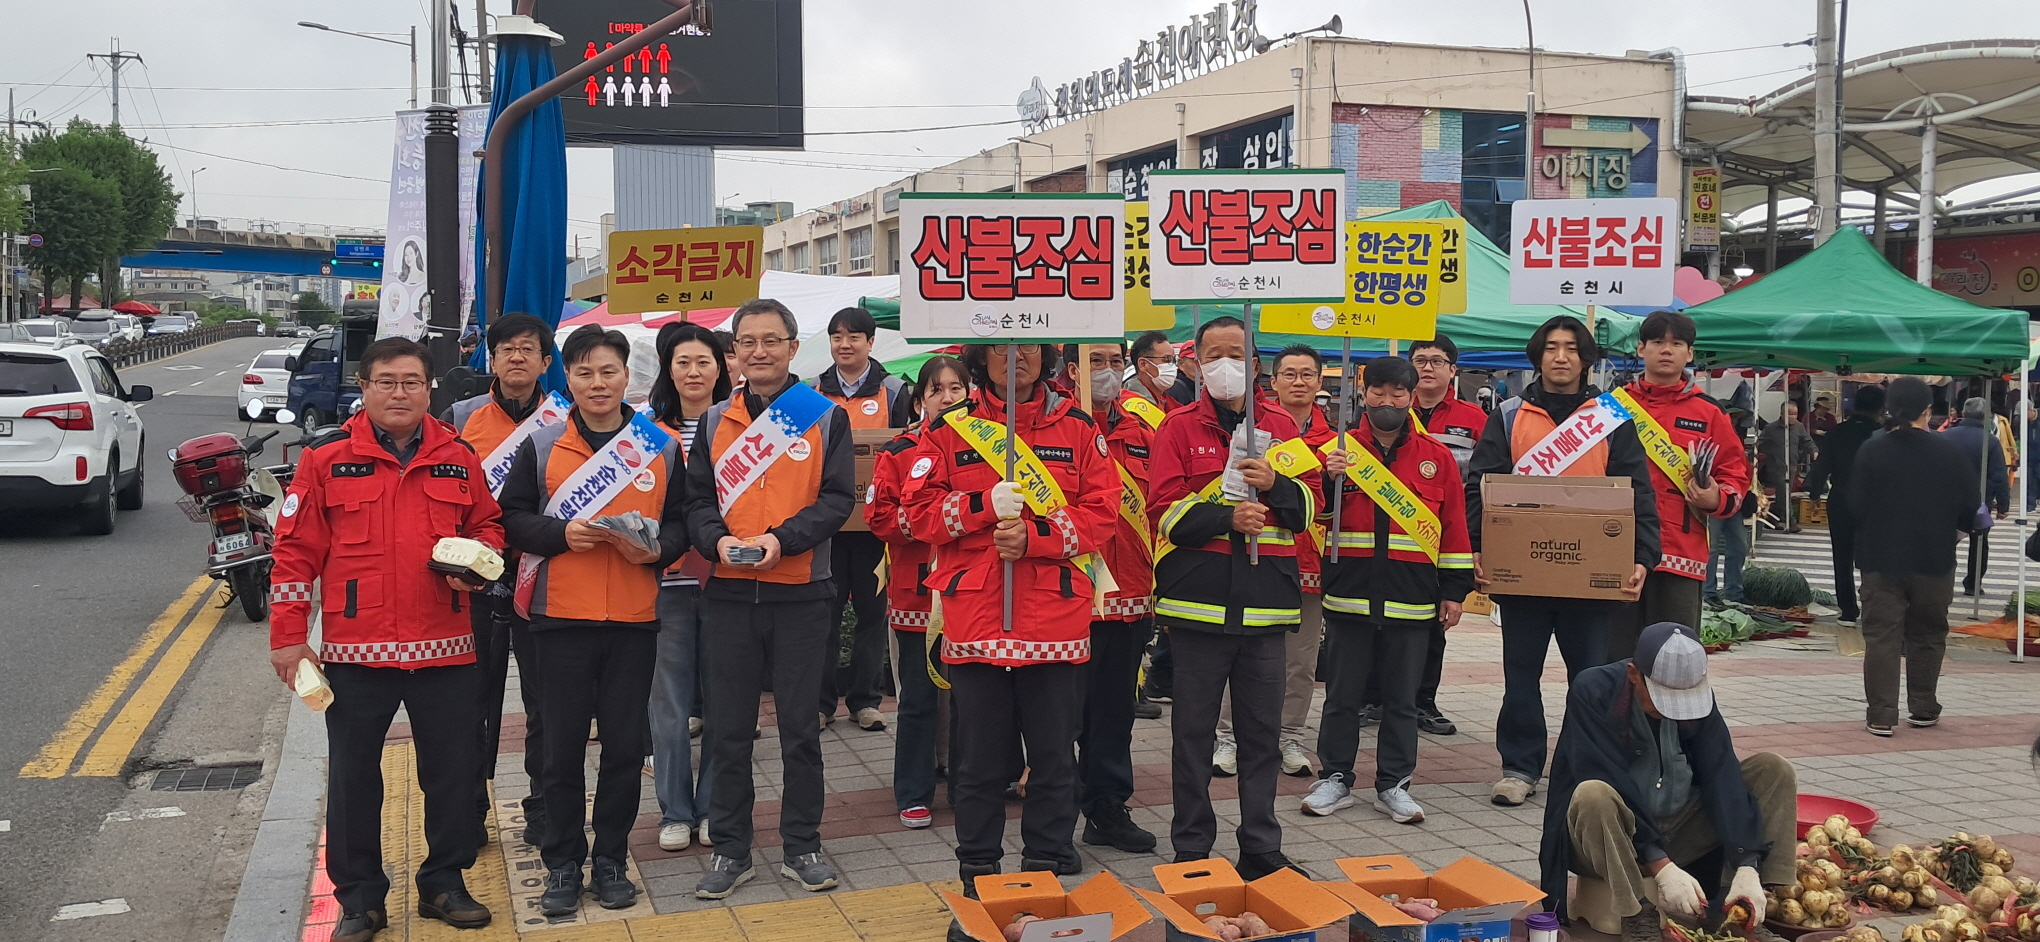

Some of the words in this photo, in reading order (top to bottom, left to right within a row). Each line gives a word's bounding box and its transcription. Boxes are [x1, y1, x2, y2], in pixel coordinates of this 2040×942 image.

[1543, 153, 1631, 189] 야시장
[1160, 188, 1336, 265] 산불조심
[1523, 215, 1663, 268] 산불조심
[616, 240, 755, 284] 소각금지
[912, 216, 1113, 300] 산불조심
[1357, 231, 1432, 266] 한순간
[1238, 275, 1281, 290] 순천시
[1353, 271, 1428, 306] 한평생
[1000, 312, 1049, 329] 순천시
[1530, 539, 1581, 551] natural
[1530, 551, 1583, 562] organic
